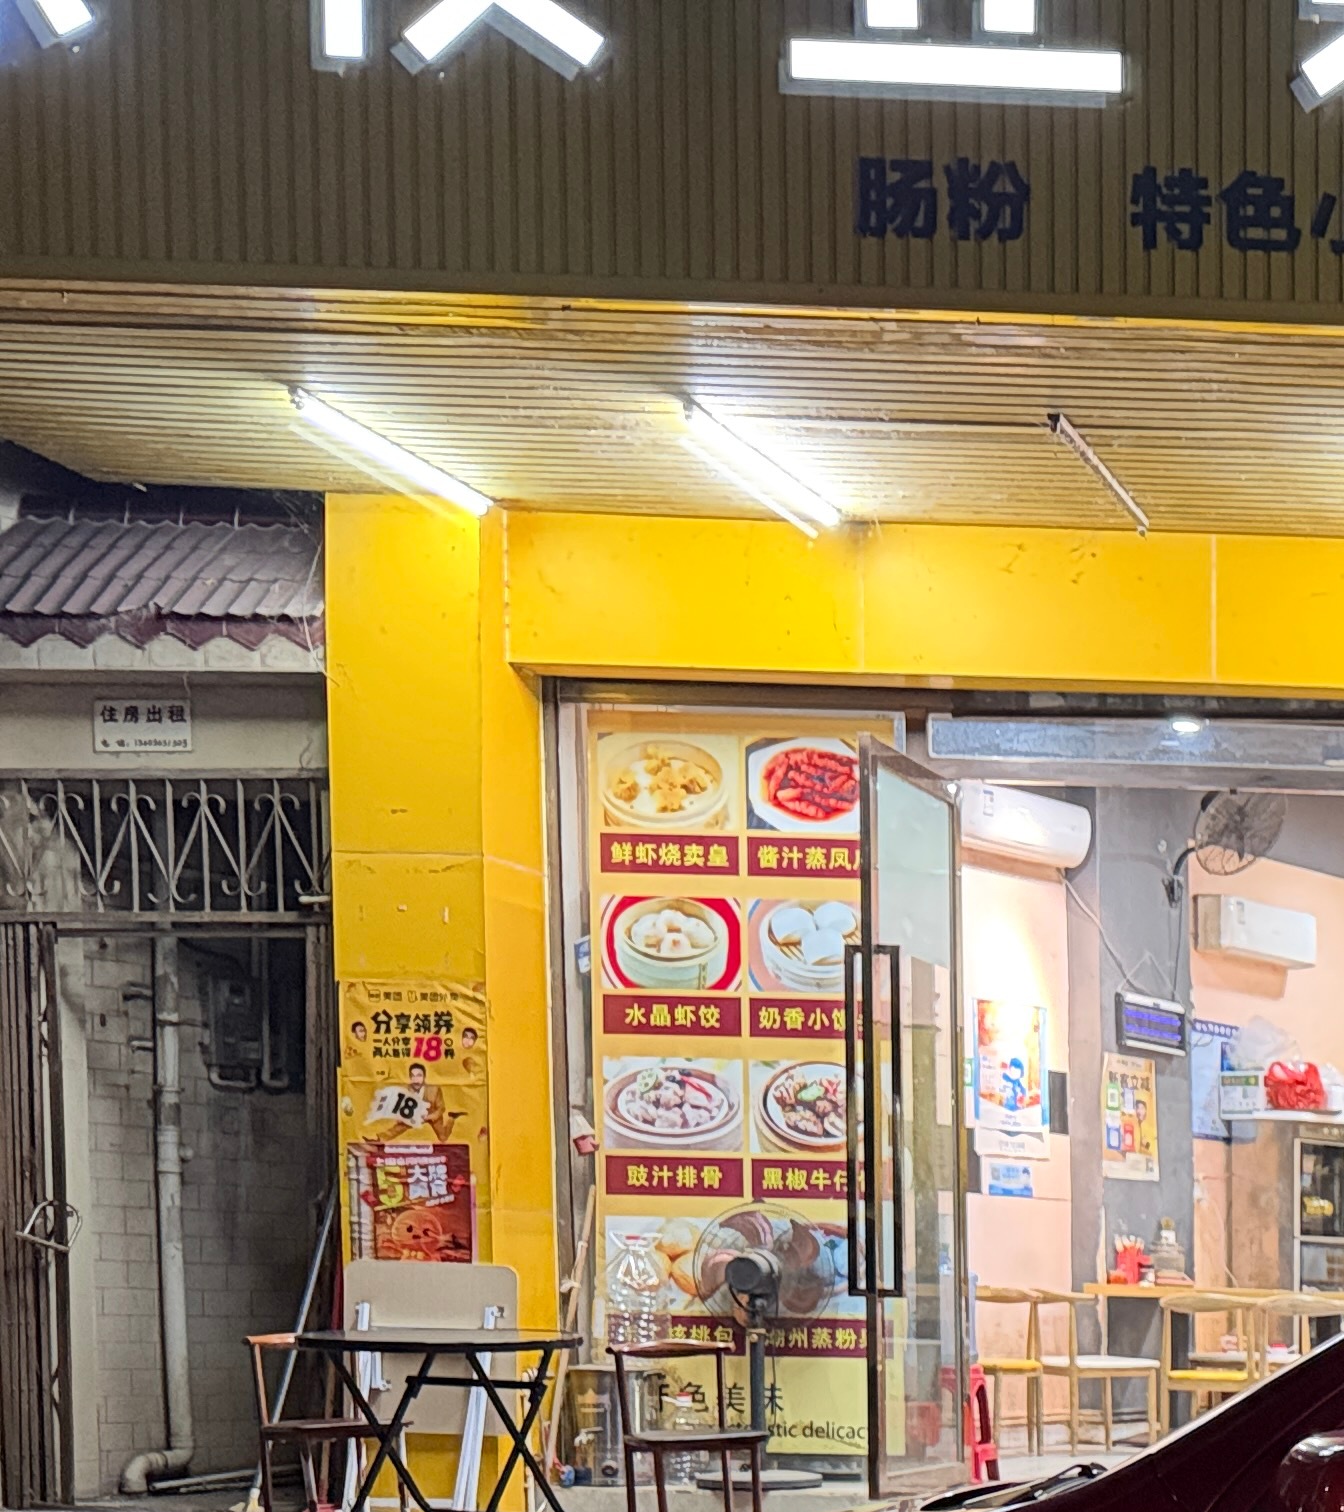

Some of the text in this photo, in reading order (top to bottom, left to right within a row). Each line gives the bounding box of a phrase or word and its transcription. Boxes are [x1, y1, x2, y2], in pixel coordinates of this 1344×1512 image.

[856, 156, 1031, 242] 肠粉
[101, 704, 187, 724] 住房出租
[610, 842, 730, 868] 鲜虾烧卖皇
[757, 845, 861, 871] 酱汁蒸凤
[371, 1009, 454, 1034] 分享领券
[625, 1003, 721, 1029] 水晶虾饺
[758, 1007, 862, 1032] 奶香小馒
[413, 1036, 442, 1061] 18
[392, 1093, 418, 1119] 18
[627, 1164, 722, 1189] 豉汁排骨
[762, 1167, 864, 1192] 黑椒牛仔
[802, 1421, 868, 1441] delicac
